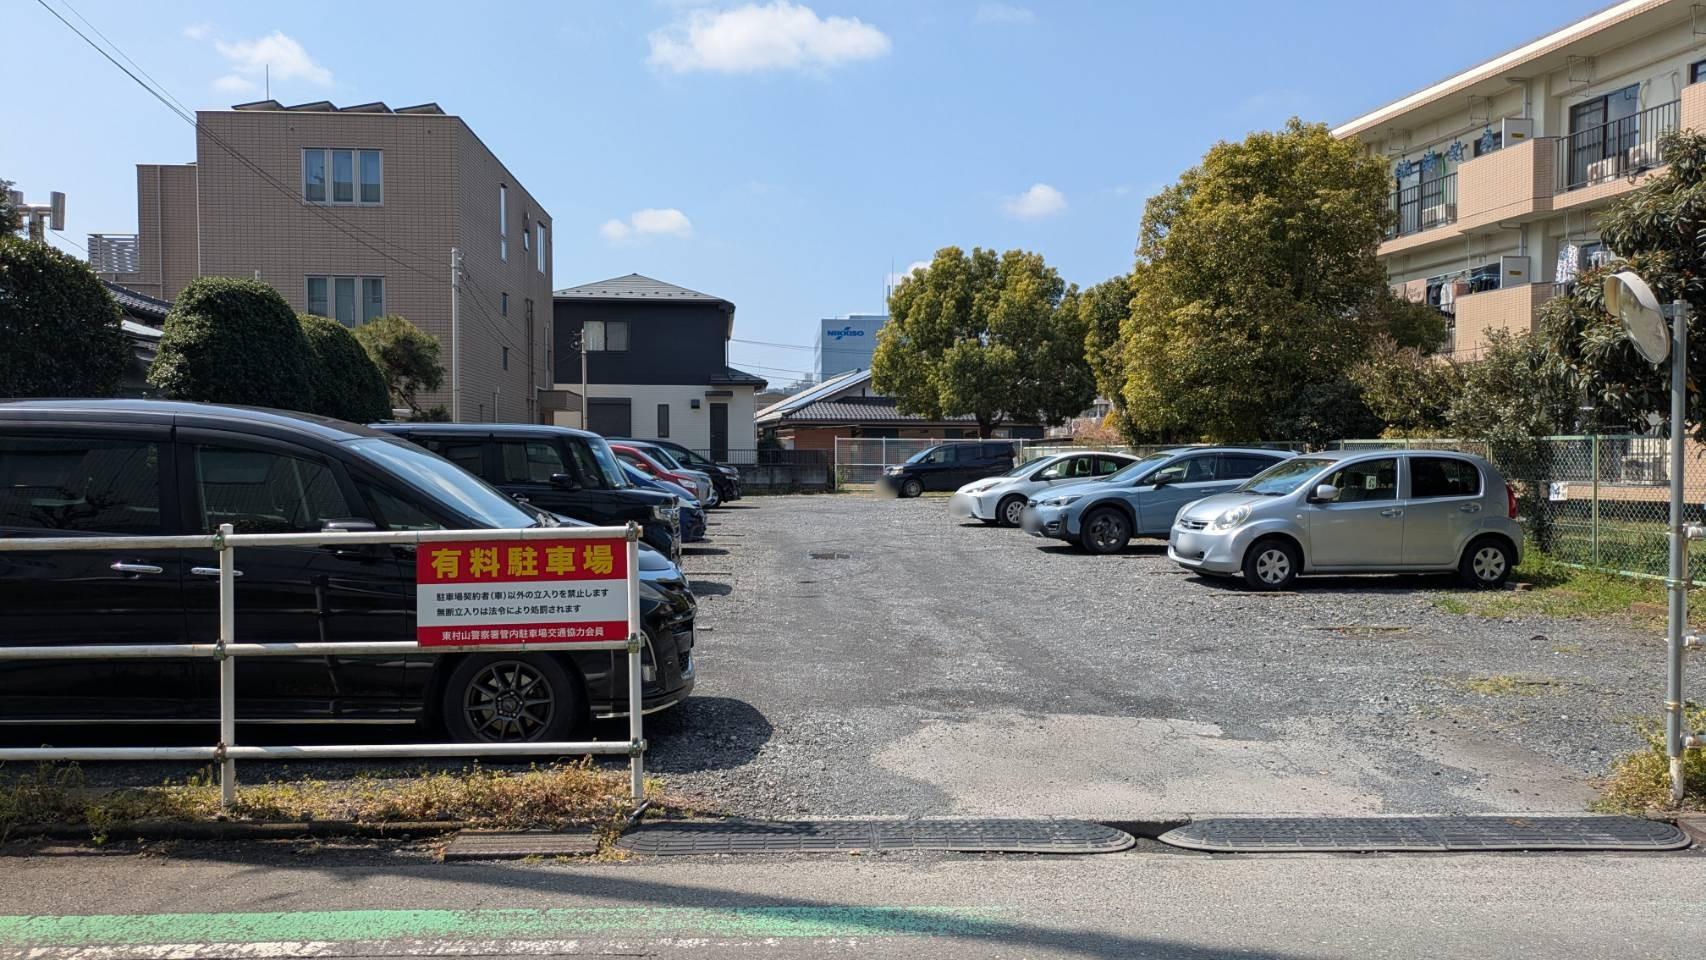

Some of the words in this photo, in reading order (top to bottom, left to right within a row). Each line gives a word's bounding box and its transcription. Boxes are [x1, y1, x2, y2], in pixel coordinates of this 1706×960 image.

[431, 544, 614, 579] 有料駐車場
[436, 604, 582, 617] 無断立入りは法令により処罰されます
[442, 626, 604, 641] 東村山警察署管内駐車場交通協力会員
